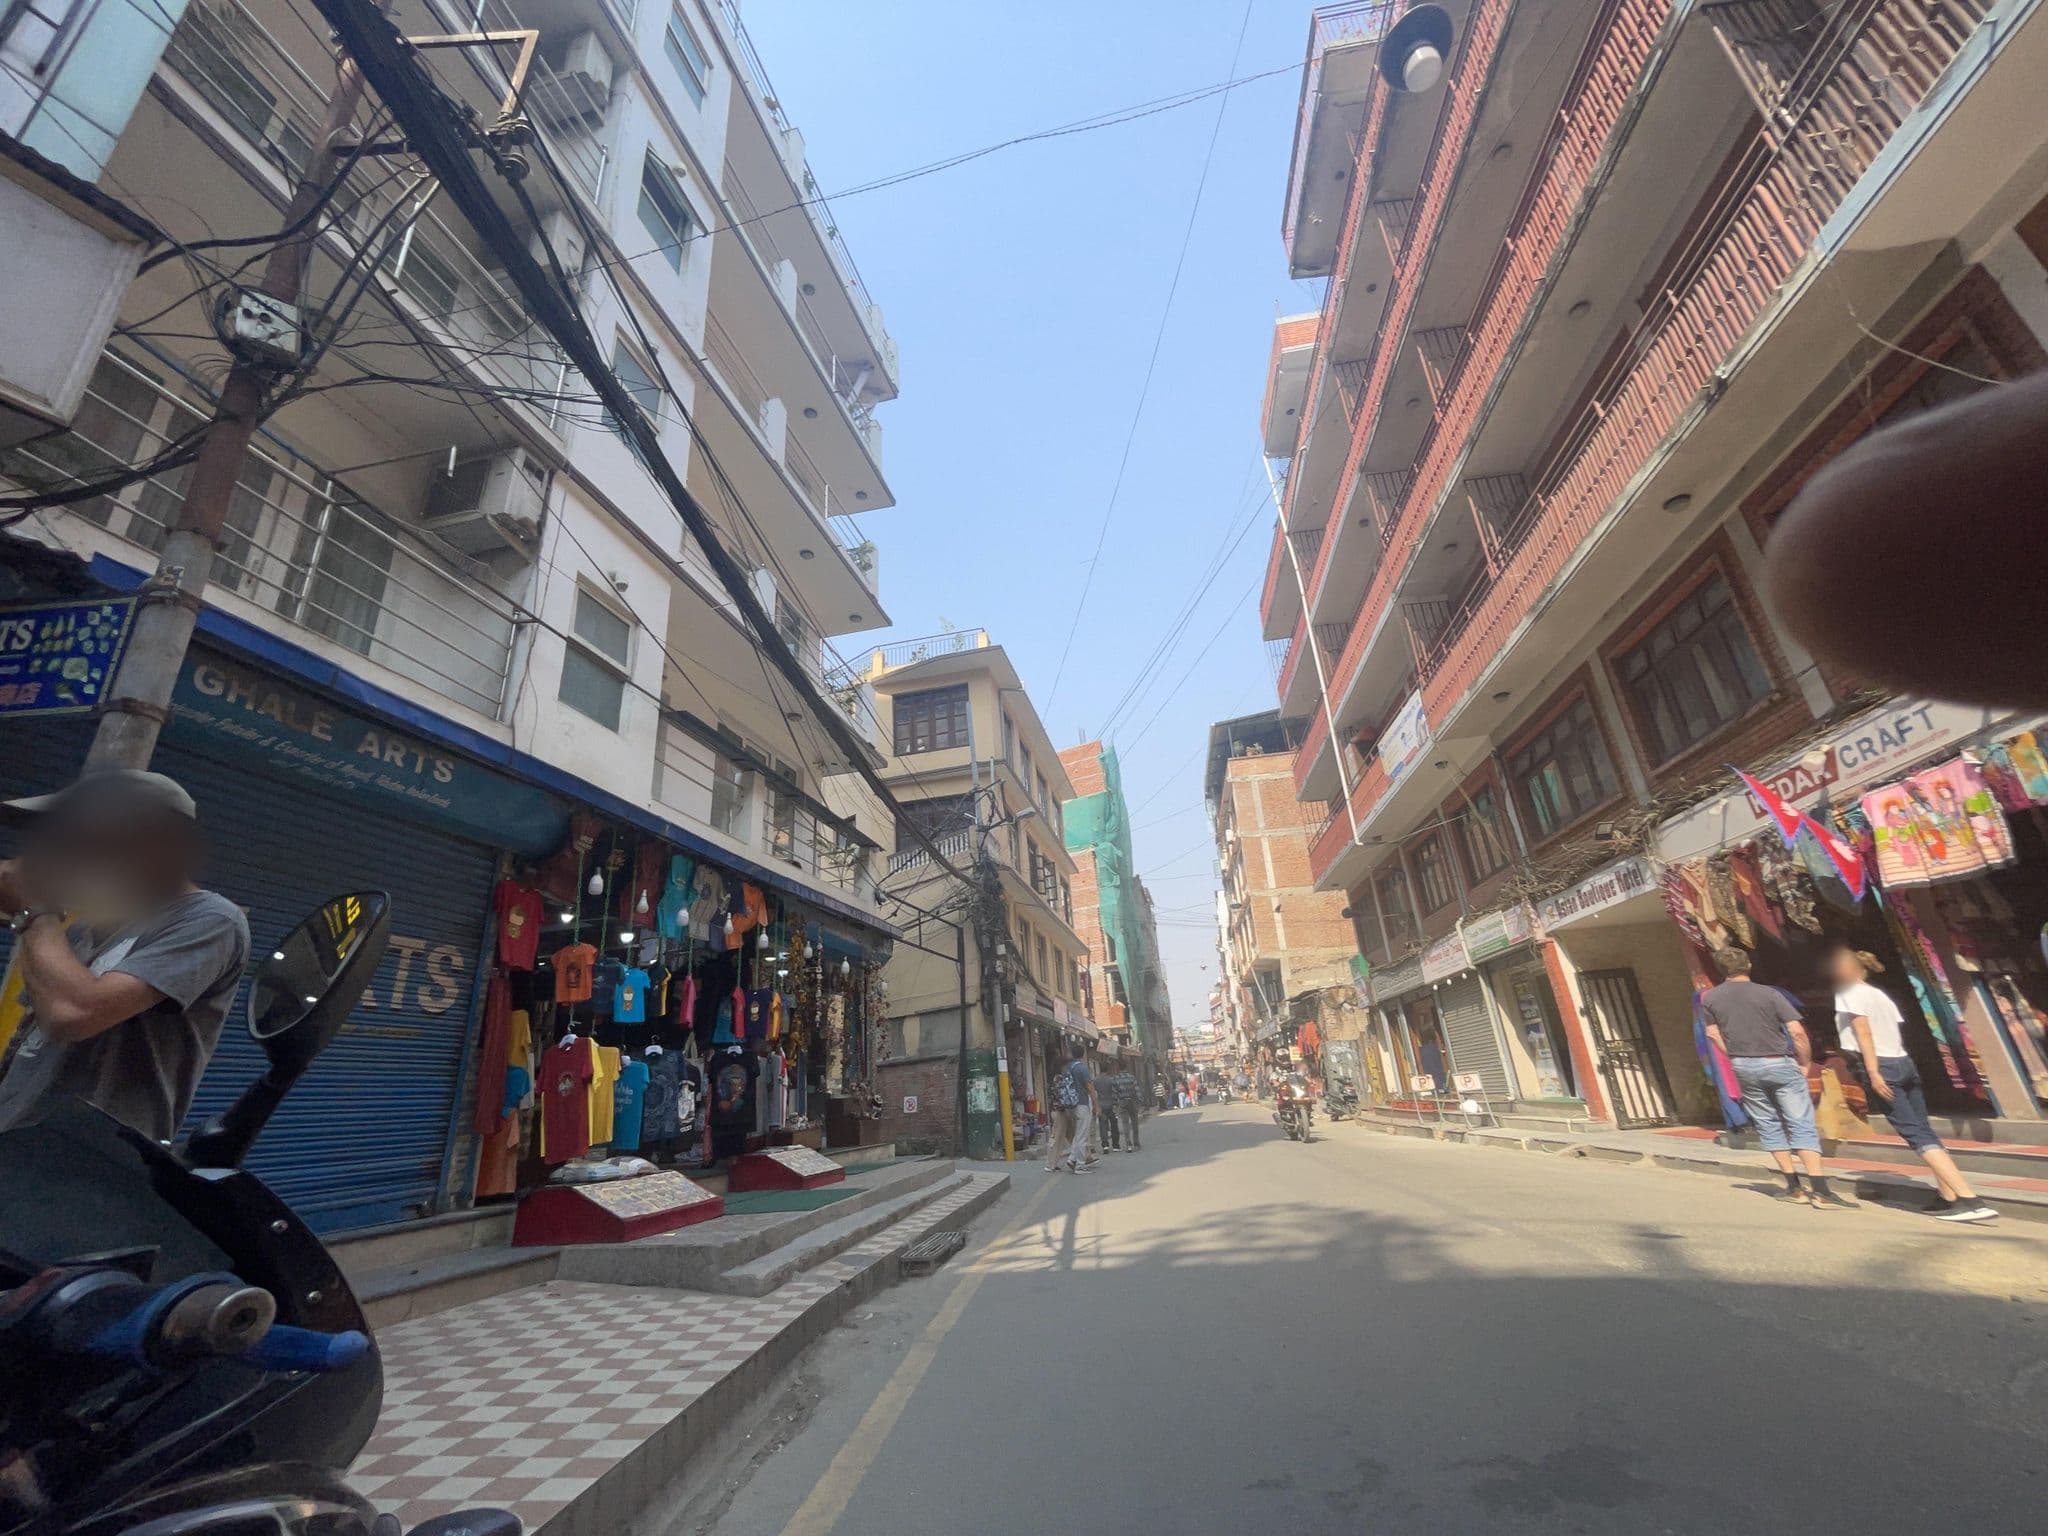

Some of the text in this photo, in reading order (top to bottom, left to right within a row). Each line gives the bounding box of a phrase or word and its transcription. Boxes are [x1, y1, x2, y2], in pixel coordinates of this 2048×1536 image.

[193, 663, 334, 742] GHALE
[356, 729, 455, 783] ARTS
[1839, 702, 1935, 769] CRAFT
[1614, 862, 1646, 893] Hotel
[362, 934, 465, 1013] TS
